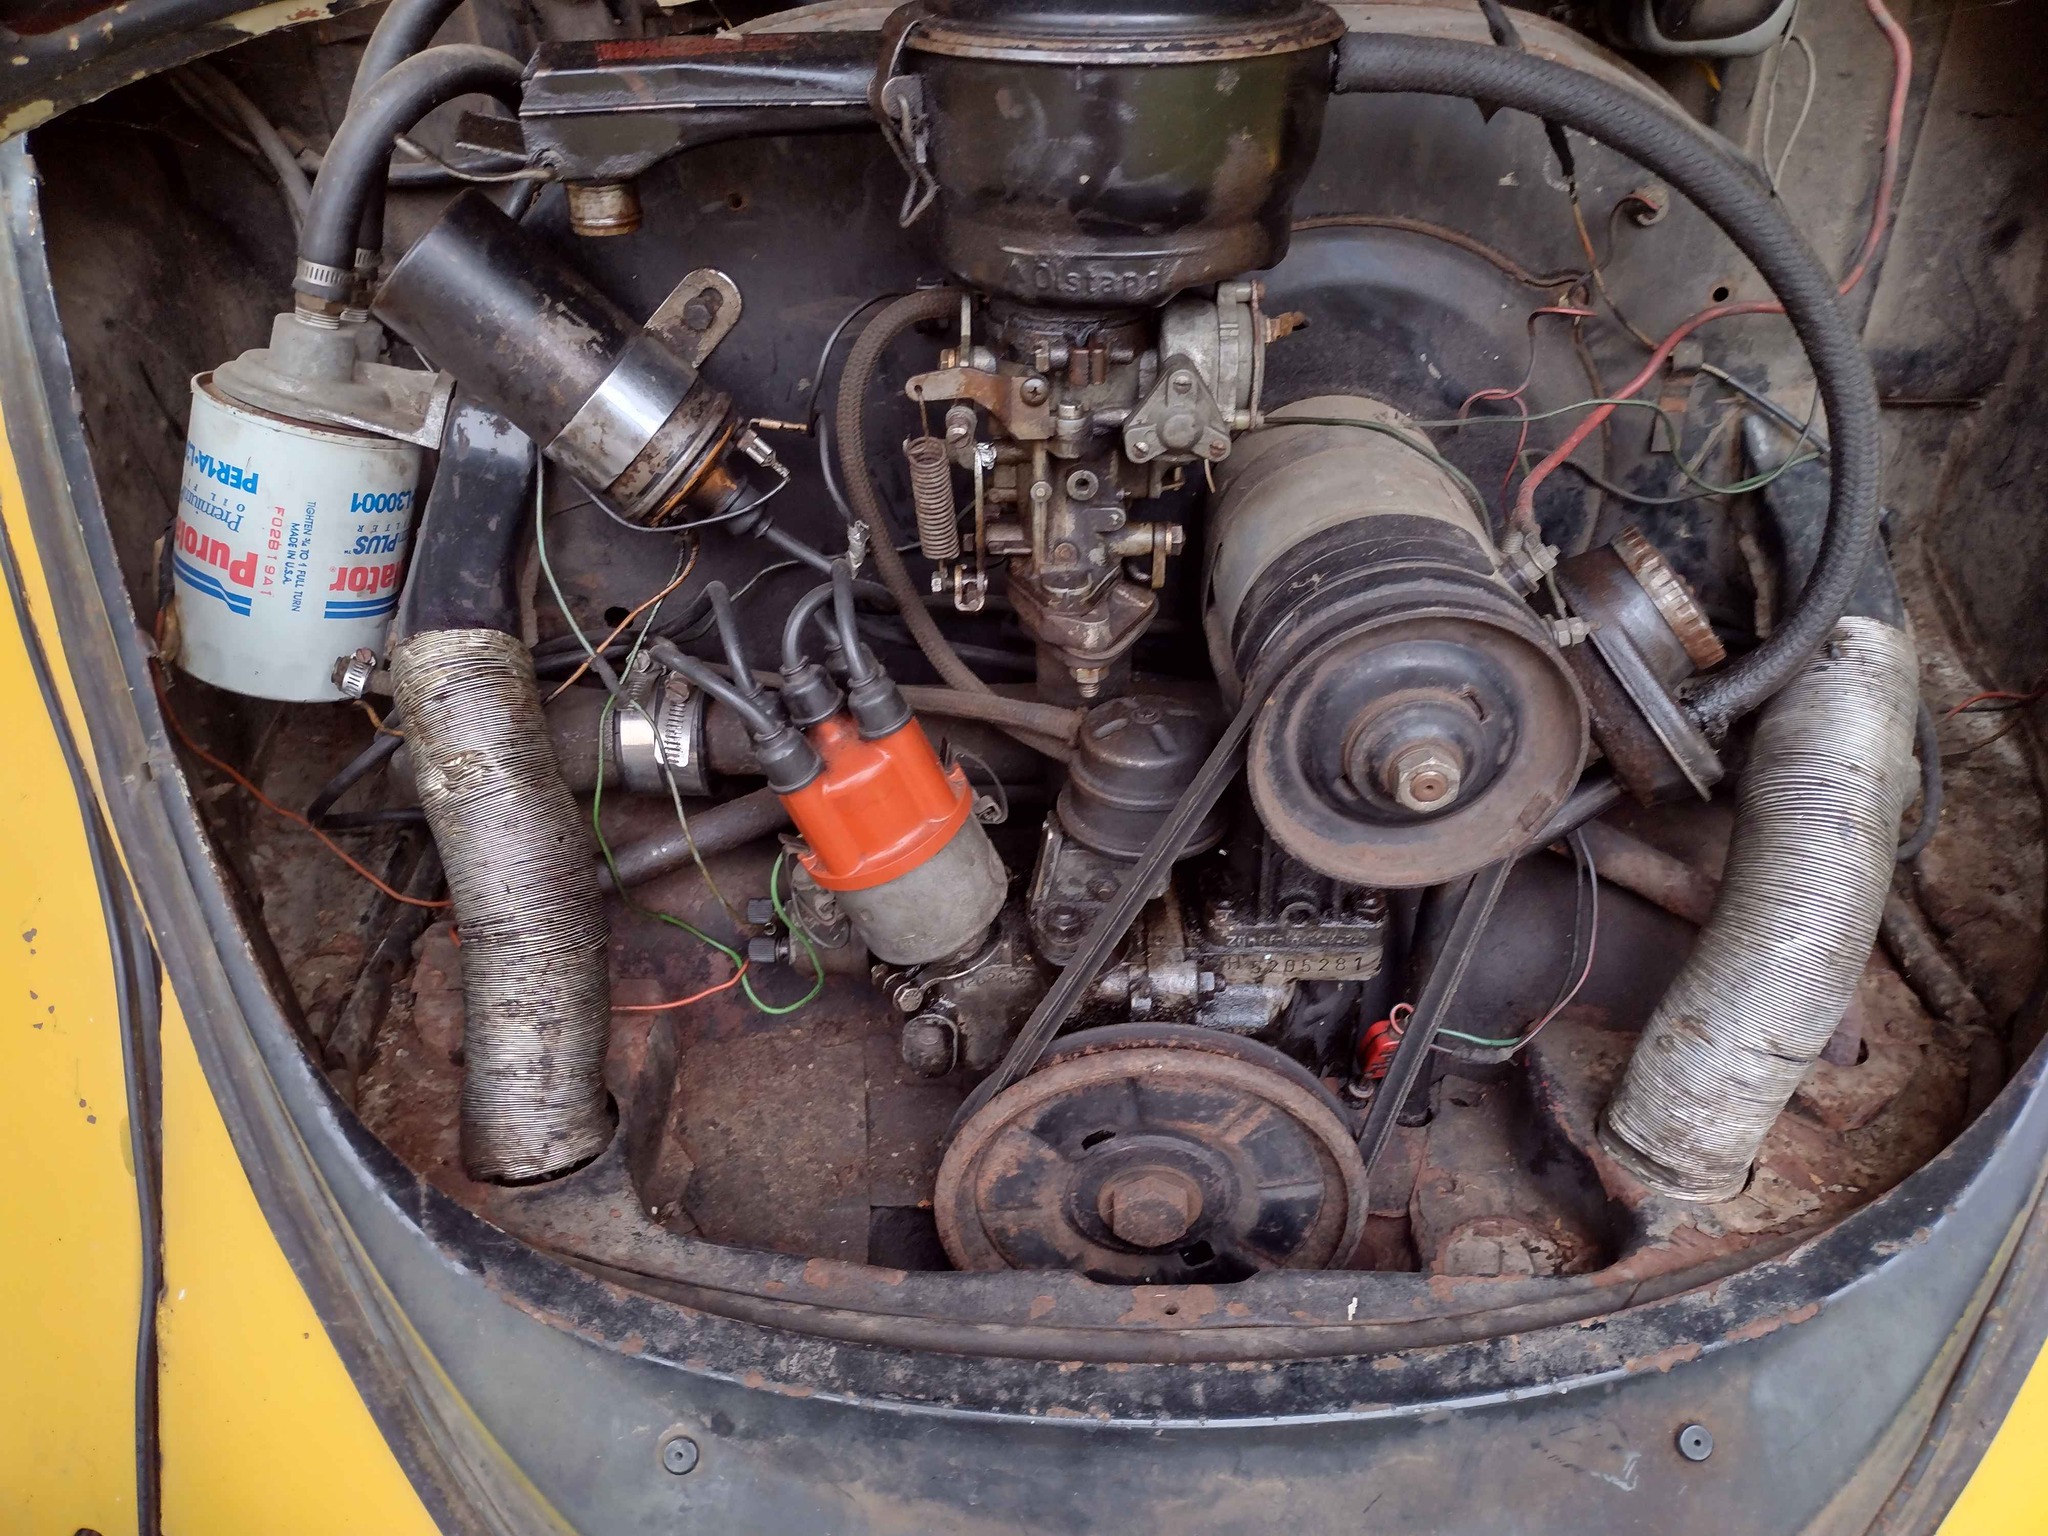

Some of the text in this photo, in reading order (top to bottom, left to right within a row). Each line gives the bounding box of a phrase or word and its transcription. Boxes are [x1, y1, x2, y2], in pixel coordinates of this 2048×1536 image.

[303, 501, 317, 536] TIGHTEN
[287, 522, 300, 548] MADE
[286, 550, 297, 560] IN
[299, 549, 310, 561] TO
[294, 569, 307, 588] FULL
[291, 591, 304, 612] TURN
